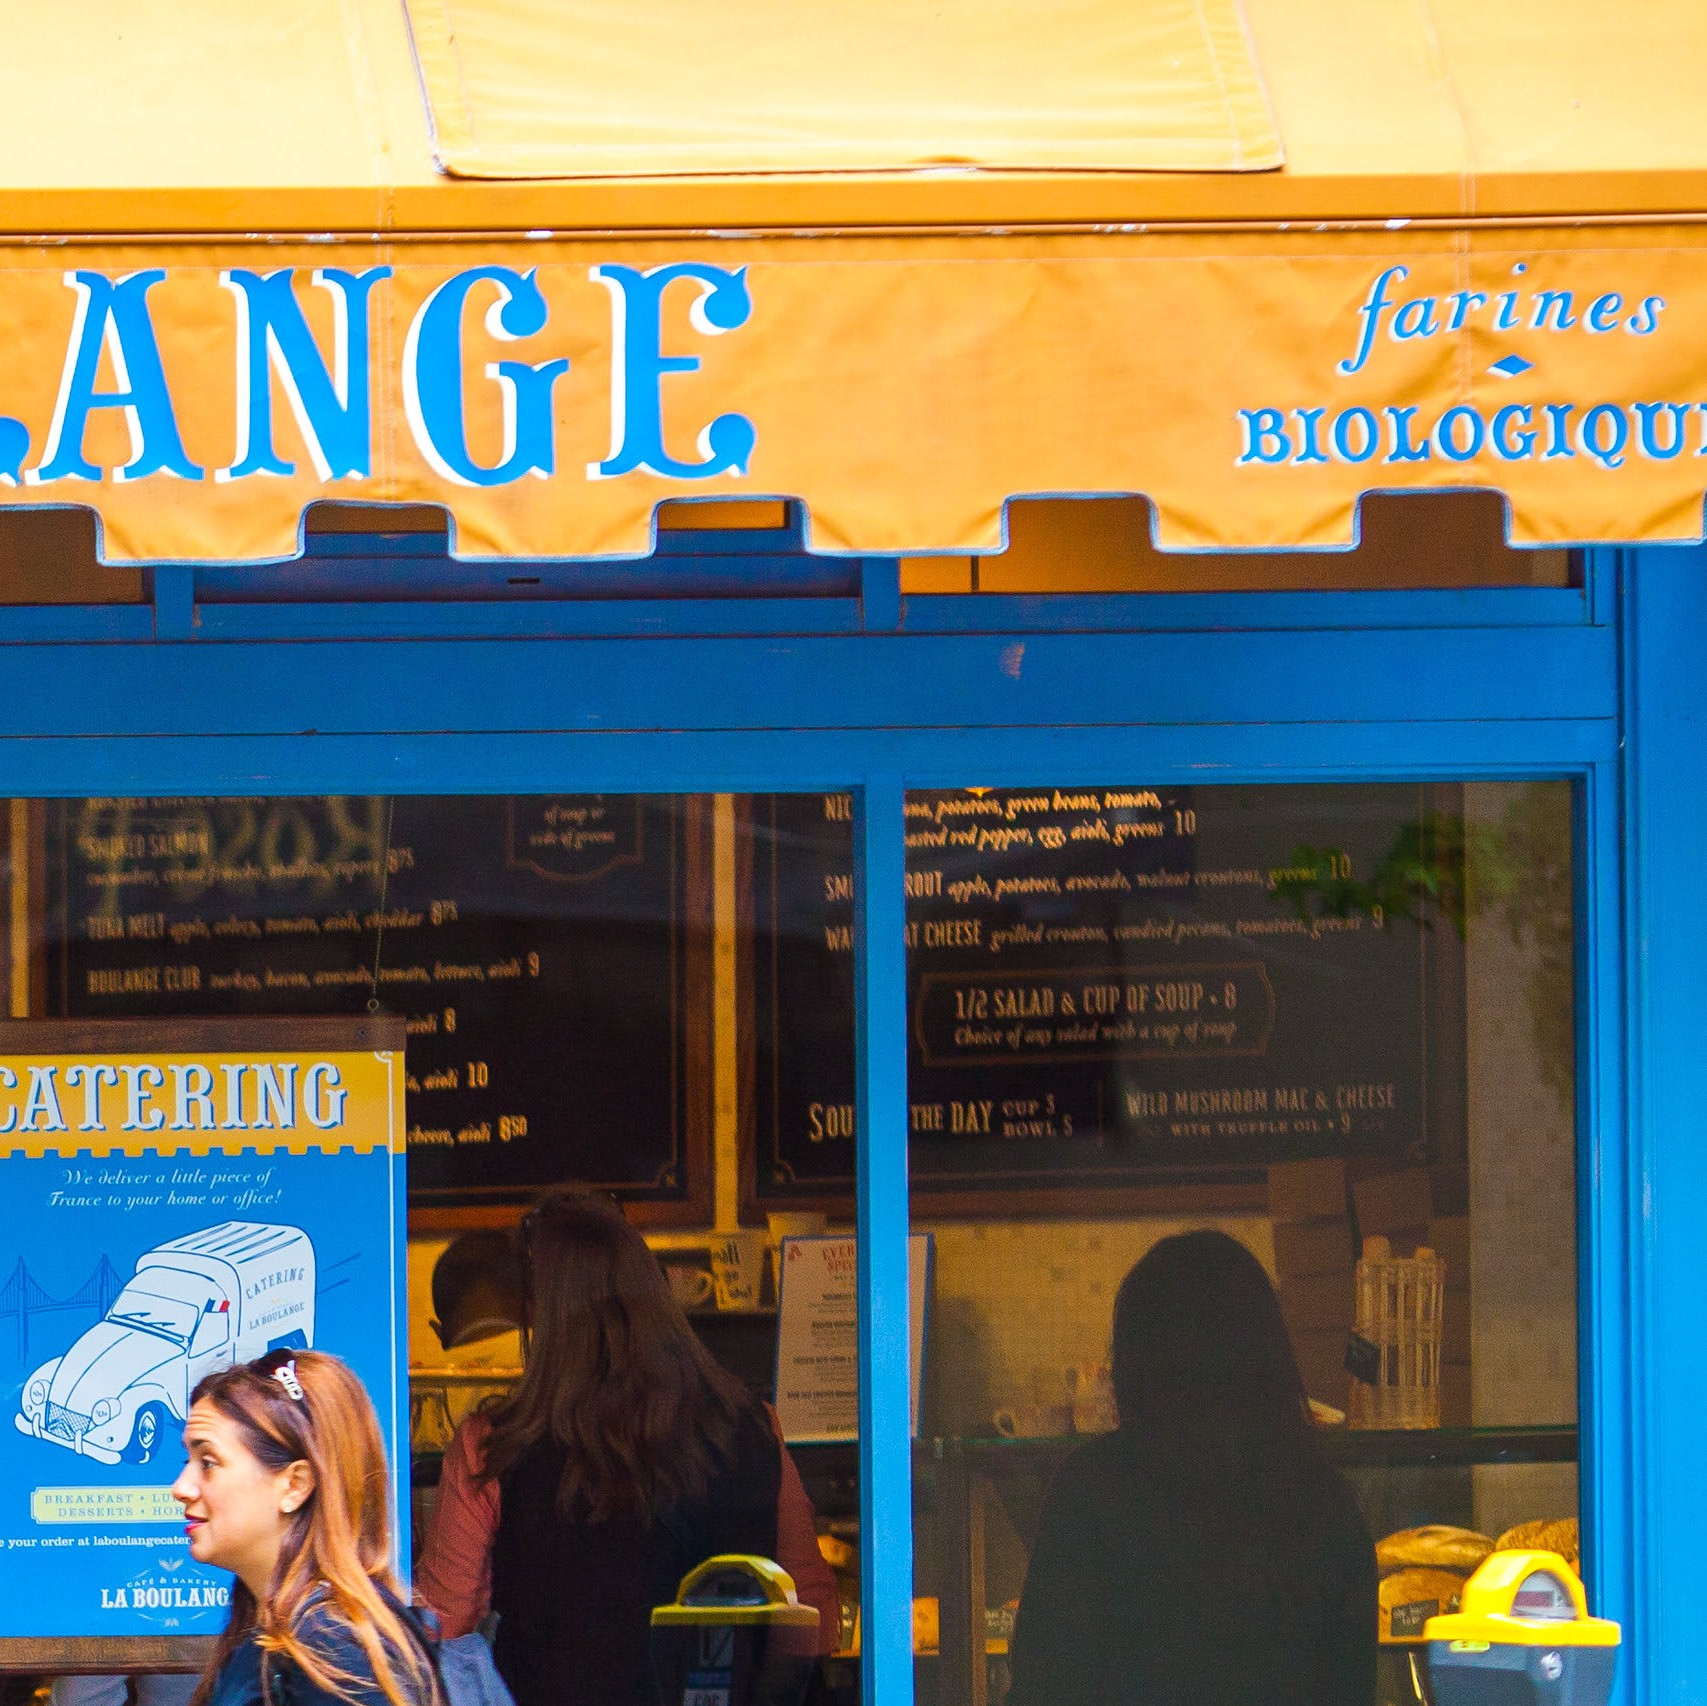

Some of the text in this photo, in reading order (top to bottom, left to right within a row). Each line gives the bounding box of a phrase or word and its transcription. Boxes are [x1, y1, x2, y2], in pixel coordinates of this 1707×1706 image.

[1335, 262, 1667, 376] farines
[1235, 400, 1707, 469] BIOLOGIQU
[1174, 808, 1196, 836] 10
[1331, 853, 1352, 880] 10
[924, 919, 983, 947] CHEESE
[1372, 904, 1384, 929] 9
[954, 986, 988, 1020] 1/2
[993, 986, 1054, 1018] SALAD
[1061, 991, 1077, 1016] &
[1082, 983, 1120, 1015] CUP
[1126, 983, 1150, 1014] OF
[1154, 982, 1203, 1013] SOUP
[467, 1061, 488, 1089] 10
[1274, 1086, 1309, 1112] MAC
[1336, 1082, 1395, 1110] CHEESE
[910, 1103, 944, 1131] THE
[950, 1100, 993, 1133] DAY
[98, 1168, 151, 1185] deliver
[156, 1174, 165, 1184] a
[171, 1168, 207, 1184] little
[209, 1168, 251, 1189] piece
[256, 1166, 277, 1189] of
[49, 1191, 102, 1207] France
[107, 1192, 121, 1206] to
[125, 1194, 162, 1211] your
[167, 1190, 206, 1206] home
[212, 1194, 228, 1205] or
[245, 1267, 305, 1299] CATERING
[45, 1493, 134, 1505] BREAKFAST
[58, 1507, 134, 1518] DESSERTS
[8, 1538, 37, 1550] your
[40, 1536, 75, 1547] order
[78, 1536, 90, 1547] at
[101, 1588, 128, 1608] LA
